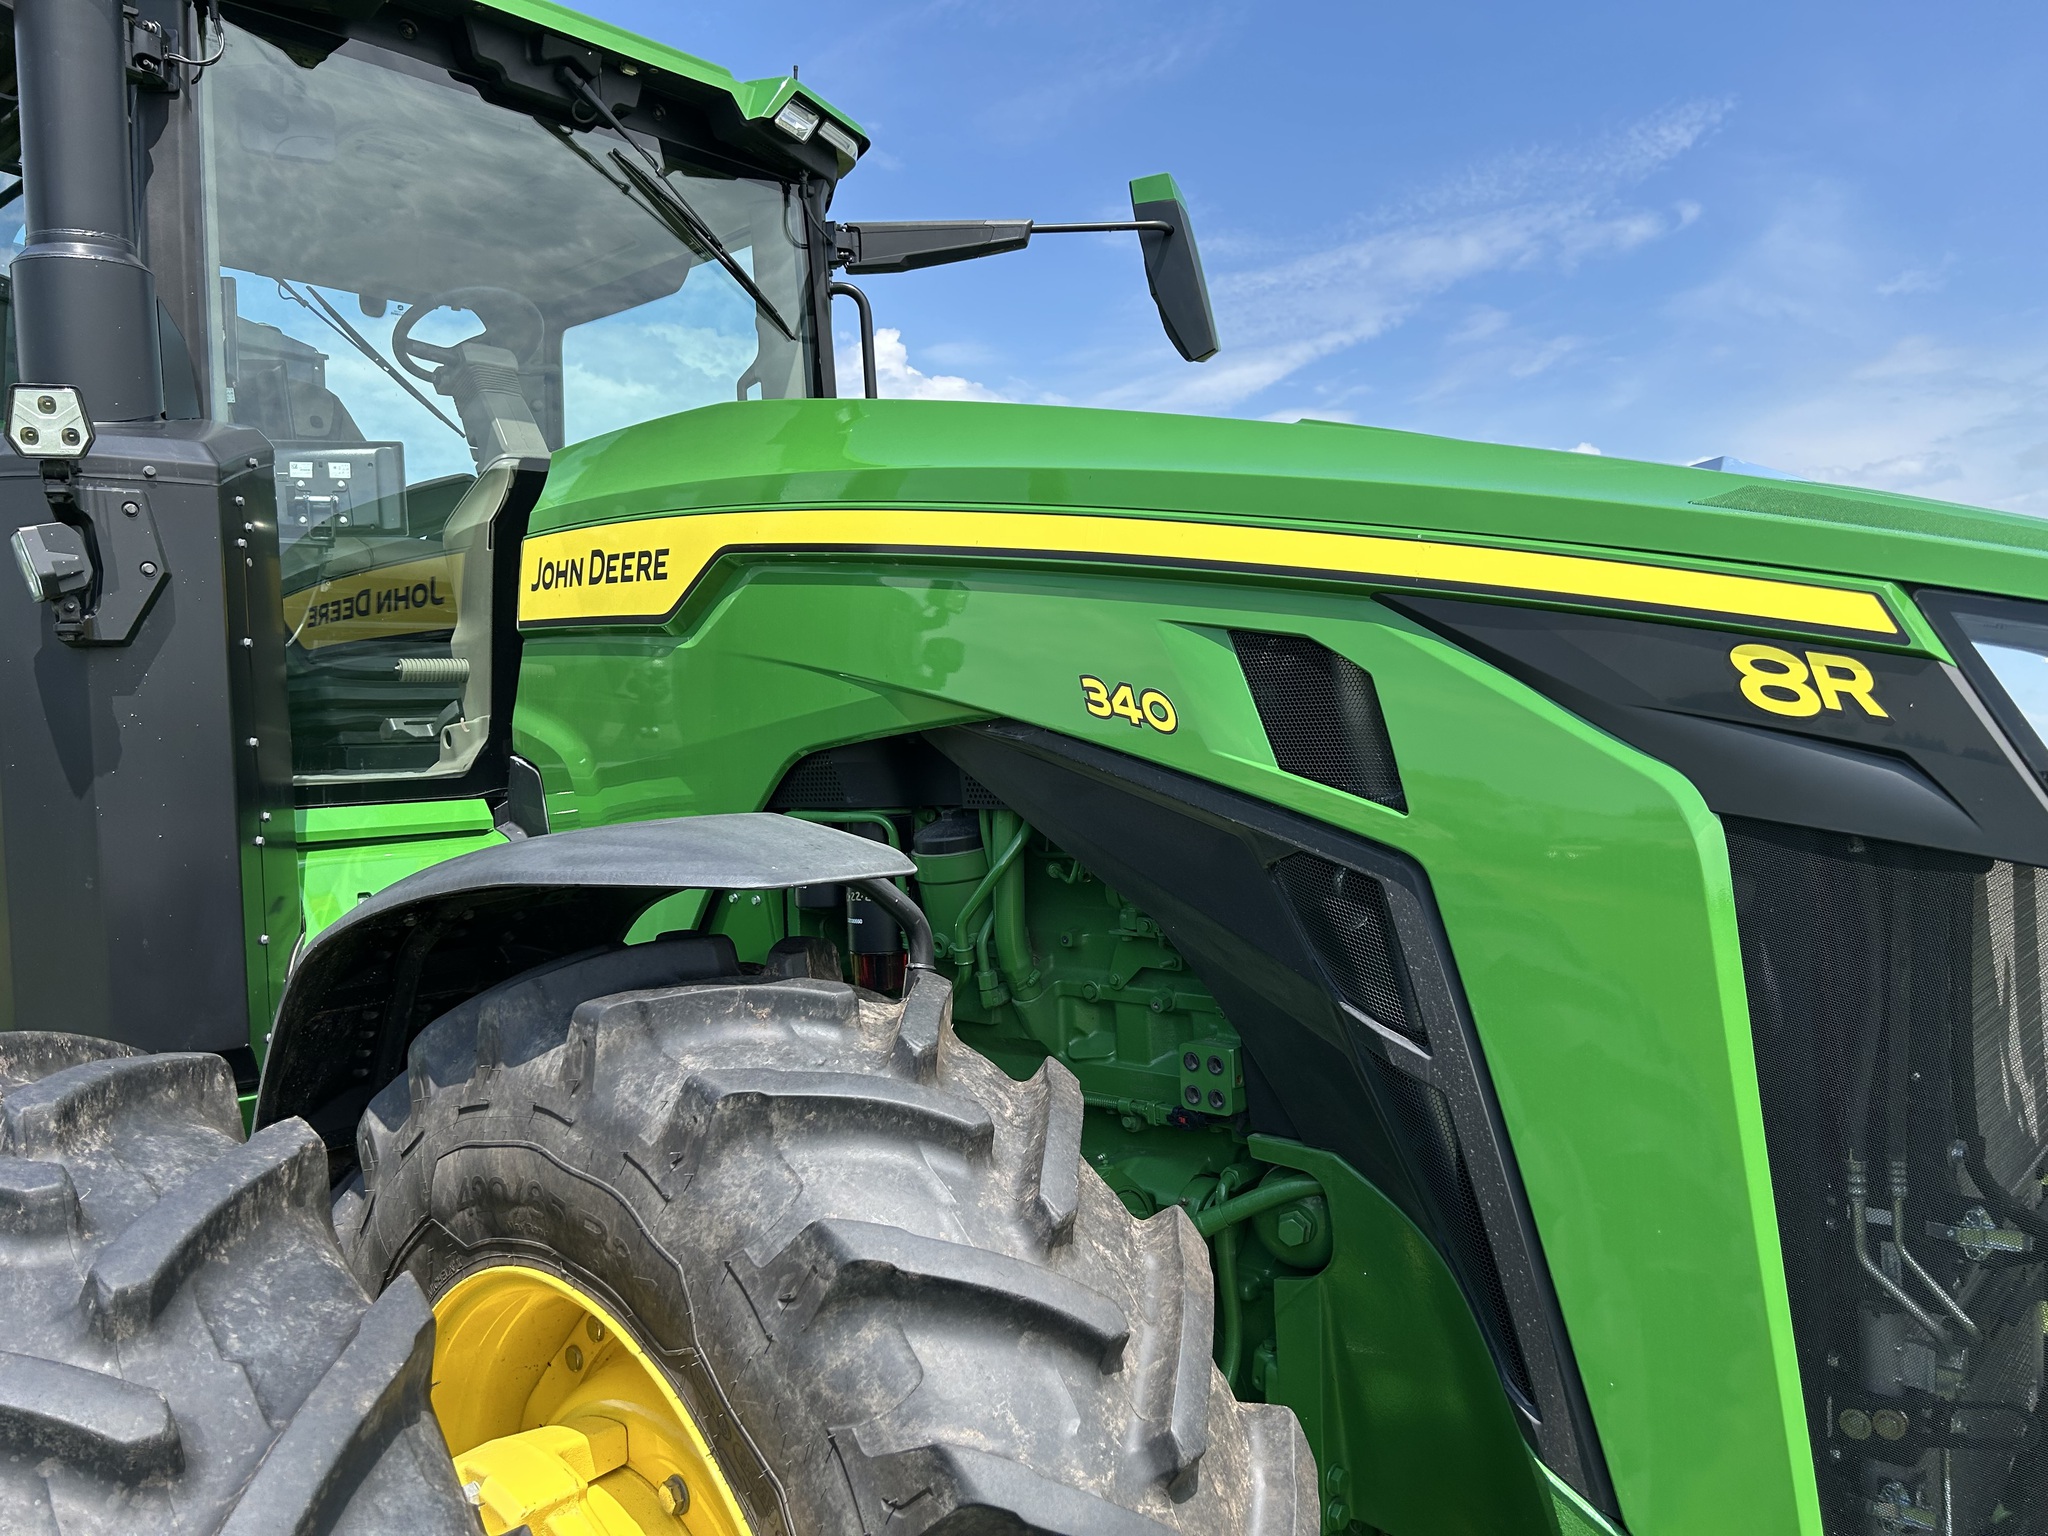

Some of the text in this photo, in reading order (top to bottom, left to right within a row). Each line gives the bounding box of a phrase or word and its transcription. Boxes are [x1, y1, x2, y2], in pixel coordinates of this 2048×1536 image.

[530, 548, 670, 592] JOHN DEERE
[1079, 674, 1179, 735] 340
[1729, 643, 1890, 718] 8R
